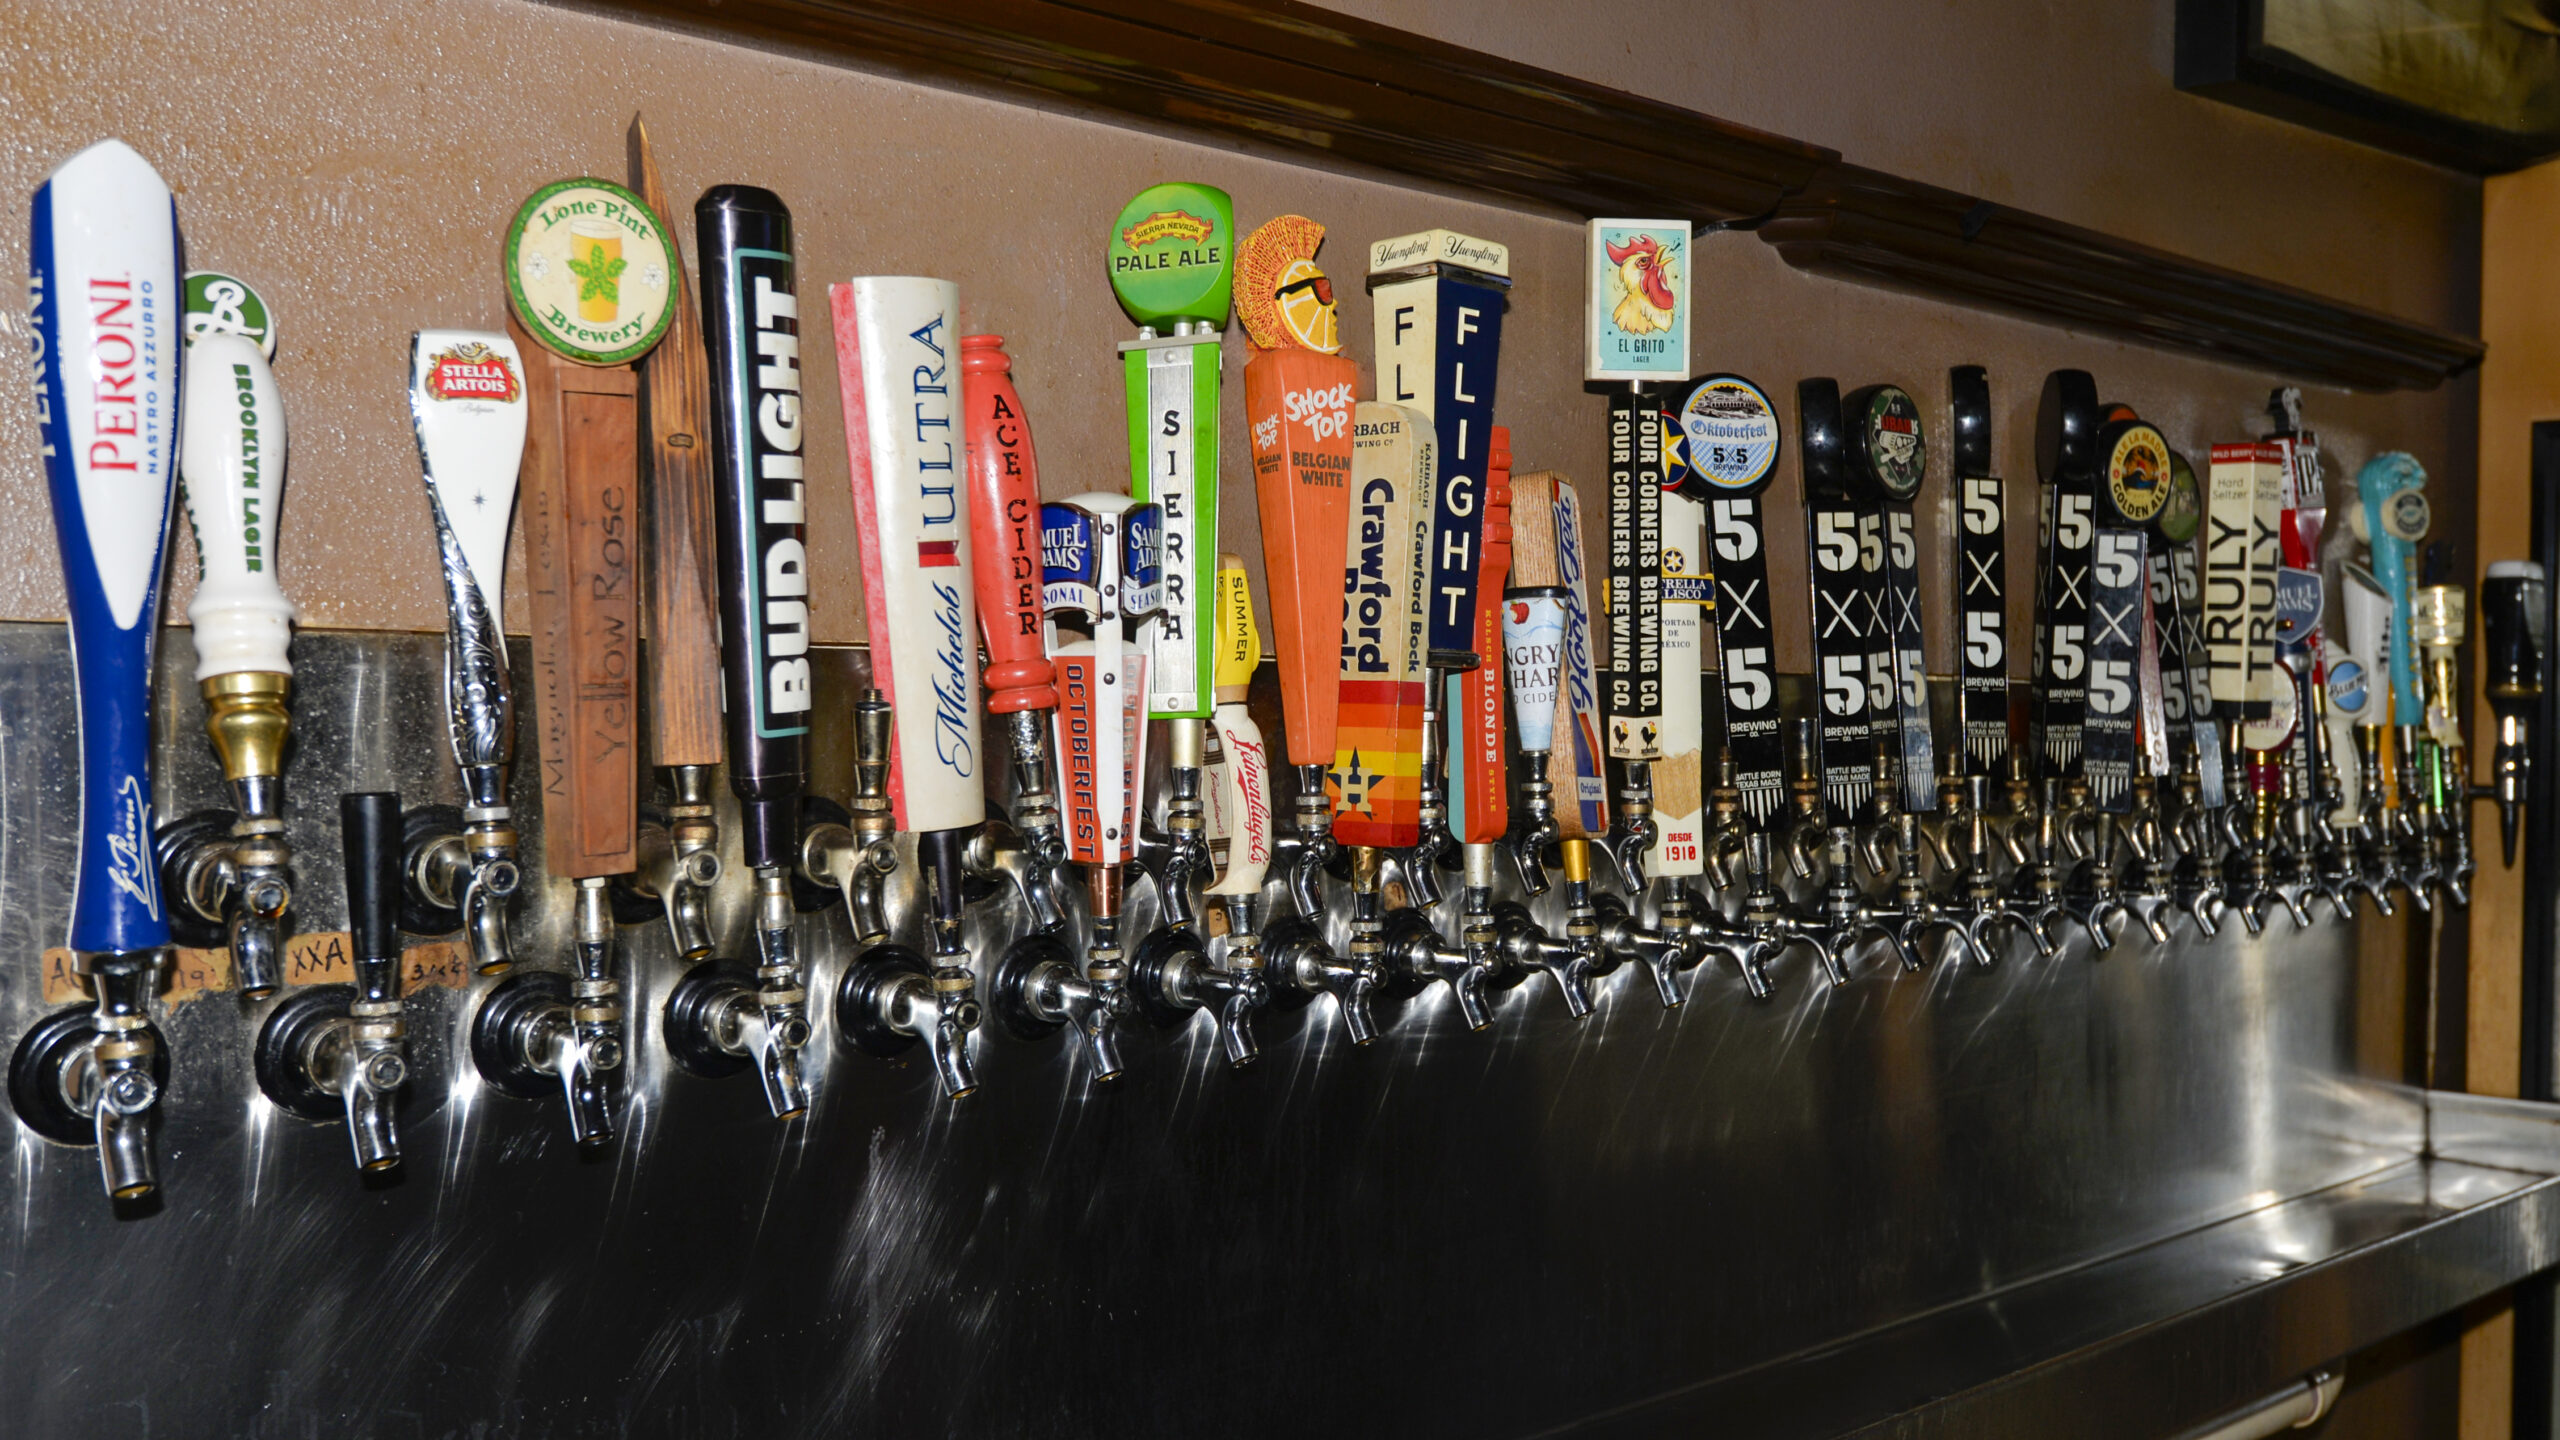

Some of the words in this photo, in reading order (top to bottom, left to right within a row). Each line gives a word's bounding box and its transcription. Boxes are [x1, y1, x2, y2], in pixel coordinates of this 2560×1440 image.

[539, 199, 599, 233] Lone
[602, 199, 653, 241] Pint
[1136, 223, 1166, 240] SIERRA
[1167, 221, 1199, 233] NEVADA
[1116, 254, 1170, 273] PALE
[1178, 247, 1221, 266] ALE
[1375, 234, 1431, 268] Yuengling
[1444, 235, 1503, 266] Yuengling
[141, 280, 158, 381] AZZURRO
[540, 303, 645, 344] Brewery
[1618, 339, 1630, 353] EL
[1634, 338, 1665, 354] GRITO
[1632, 355, 1650, 364] LAGER
[89, 271, 139, 473] PERONI
[441, 364, 505, 379] STELLA
[443, 378, 507, 393] ARTOIS
[754, 275, 806, 525] LIGHT
[1285, 382, 1355, 422] SHOCK
[147, 390, 159, 476] NASTRO
[232, 364, 260, 490] BROOKLYN
[909, 309, 957, 529] ULTRA
[993, 394, 1022, 477] ACE
[1303, 410, 1348, 443] TOP
[1353, 421, 1400, 438] RBACH
[1690, 419, 1768, 440] Oktoberfest
[1258, 429, 1278, 451] TOP
[1354, 440, 1382, 448] WING
[1613, 410, 1631, 464] FOUR
[1639, 410, 1658, 464] FOUR
[1260, 464, 1279, 475] WHITE
[1292, 451, 1352, 471] BELGIAN
[1422, 443, 1432, 509] KARBACH
[1442, 306, 1480, 627] FLIGHT
[1713, 463, 1749, 472] BREWING
[1299, 469, 1344, 488] WHITE
[2217, 478, 2244, 489] Hard
[2113, 483, 2150, 518] GOLDEN
[2151, 484, 2168, 512] ALE
[2212, 490, 2248, 501] Seltzer
[242, 497, 262, 573] LAGER
[1042, 523, 1087, 550] MUEL
[1162, 410, 1185, 640] SIERRA
[1613, 471, 1631, 569] CORNERS
[1639, 471, 1658, 569] CORNERS
[591, 486, 628, 602] Rose
[1553, 496, 1580, 585] Tea
[1006, 498, 1038, 636] CIDER
[1358, 478, 1395, 673] Crawford
[1411, 520, 1428, 615] Crawford
[1043, 588, 1085, 606] SONAL
[1130, 588, 1161, 610] SEASO
[1661, 589, 1702, 600] LISCO
[2206, 514, 2248, 683] TRULY
[2248, 514, 2279, 682] TRULY
[764, 537, 812, 715] BUD
[1231, 577, 1248, 662] SUMMER
[1613, 576, 1631, 673] BREWING
[1640, 576, 1658, 674] BREWING
[1667, 629, 1680, 637] DE
[1408, 621, 1423, 673] Bock
[1508, 643, 1559, 667] NGRY
[577, 615, 629, 764] Yellow
[932, 580, 974, 779] Michelob
[1613, 679, 1631, 712] CO.
[1965, 677, 2005, 688] BREWING
[2048, 688, 2085, 699] BREWING
[1523, 691, 1555, 704] CIDE
[1640, 680, 1658, 713] CO.
[1484, 668, 1498, 764] BLONDE
[1730, 720, 1777, 733] BREWING
[1824, 726, 1869, 738] BREWING
[1967, 721, 1988, 729] BATTLE
[1988, 721, 2007, 729] BORN
[2085, 718, 2132, 730] BREWING
[1066, 663, 1096, 858] OCTOBERFEST
[1736, 772, 1760, 781] BATTLE
[1760, 770, 1782, 779] BORN
[1826, 767, 1850, 775] BATTLE
[1851, 765, 1871, 774] BORN
[1487, 769, 1497, 812] STYLE
[1581, 783, 1603, 797] Original
[1736, 780, 1759, 789] TEXAS
[1760, 778, 1782, 787] MADE
[1826, 774, 1849, 783] TEXAS
[1850, 772, 1871, 781] MADE
[1226, 729, 1271, 866] Leinenkugel's
[1665, 845, 1697, 862] 1910
[1667, 832, 1694, 843] DESDE
